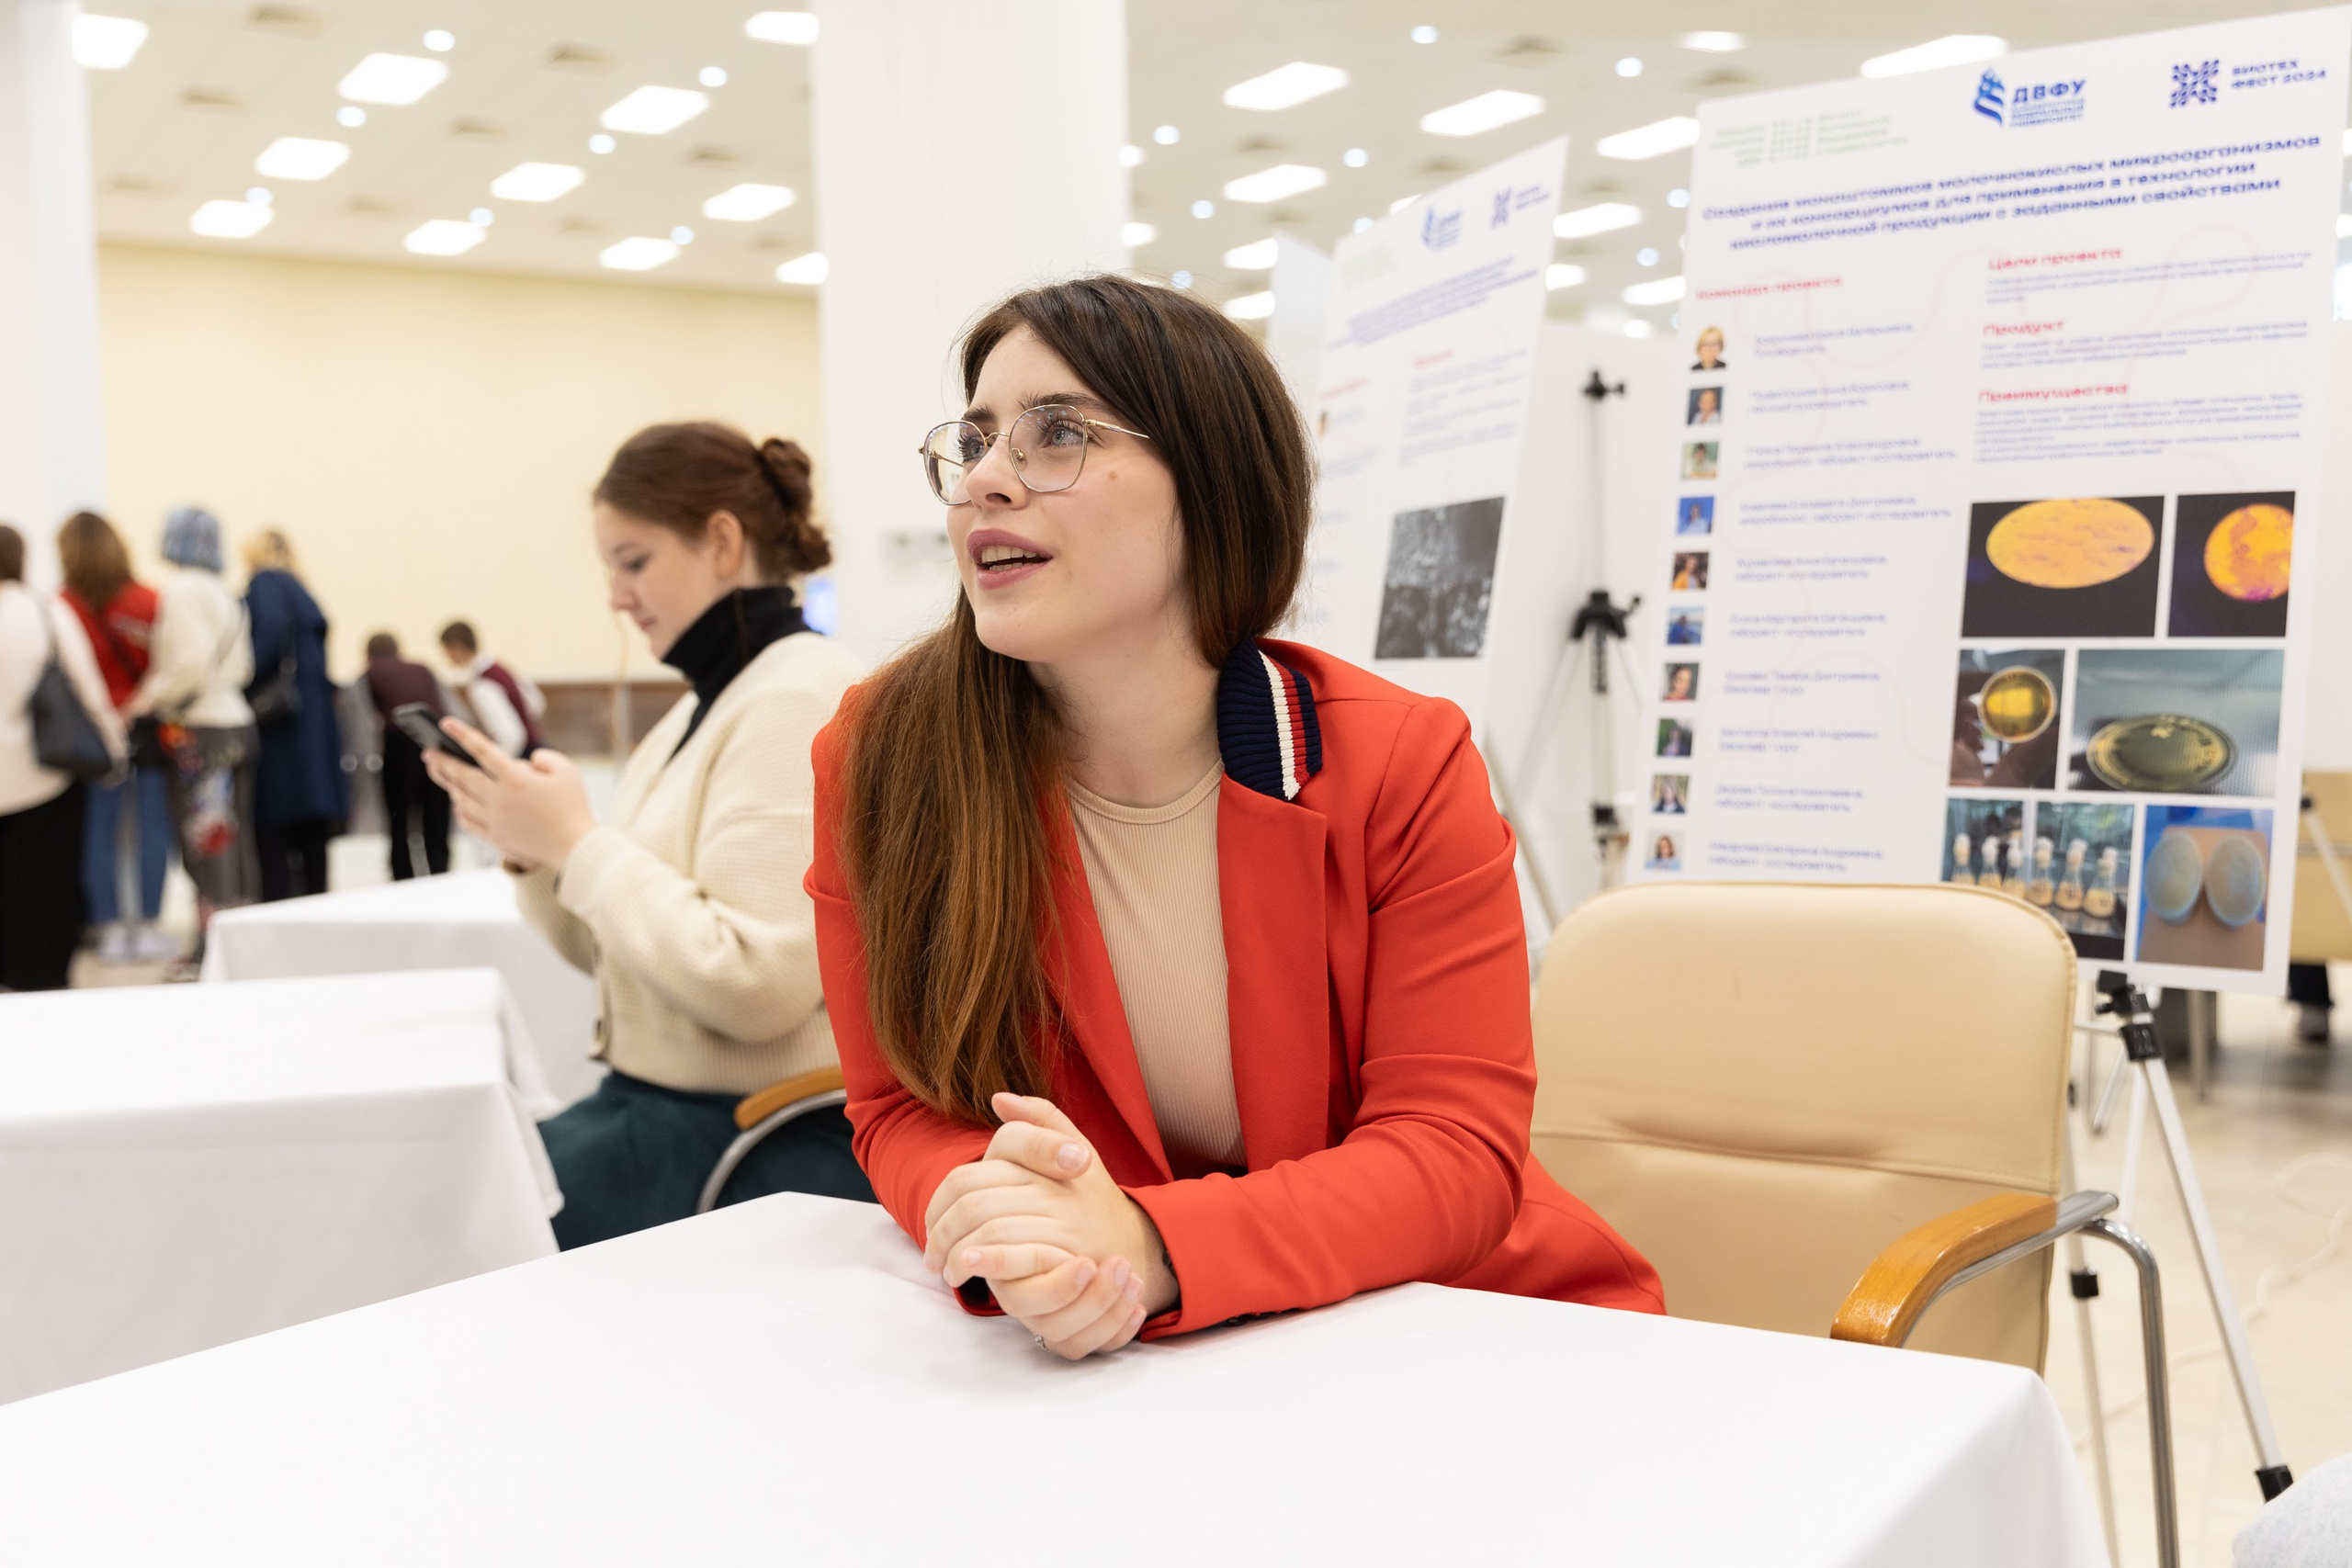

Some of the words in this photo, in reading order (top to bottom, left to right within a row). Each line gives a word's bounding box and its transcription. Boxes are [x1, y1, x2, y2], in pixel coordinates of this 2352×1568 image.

[2233, 60, 2298, 74] БИОТЕХ
[2014, 79, 2086, 103] ДВФУ
[2232, 75, 2278, 89] ФЕСТ
[2283, 70, 2326, 84] 2024
[2110, 136, 2320, 167] микроорганизмов
[2111, 177, 2121, 188] в
[2129, 163, 2255, 186] технологии
[2012, 194, 2135, 217] заданными
[2142, 179, 2280, 204] свойствами
